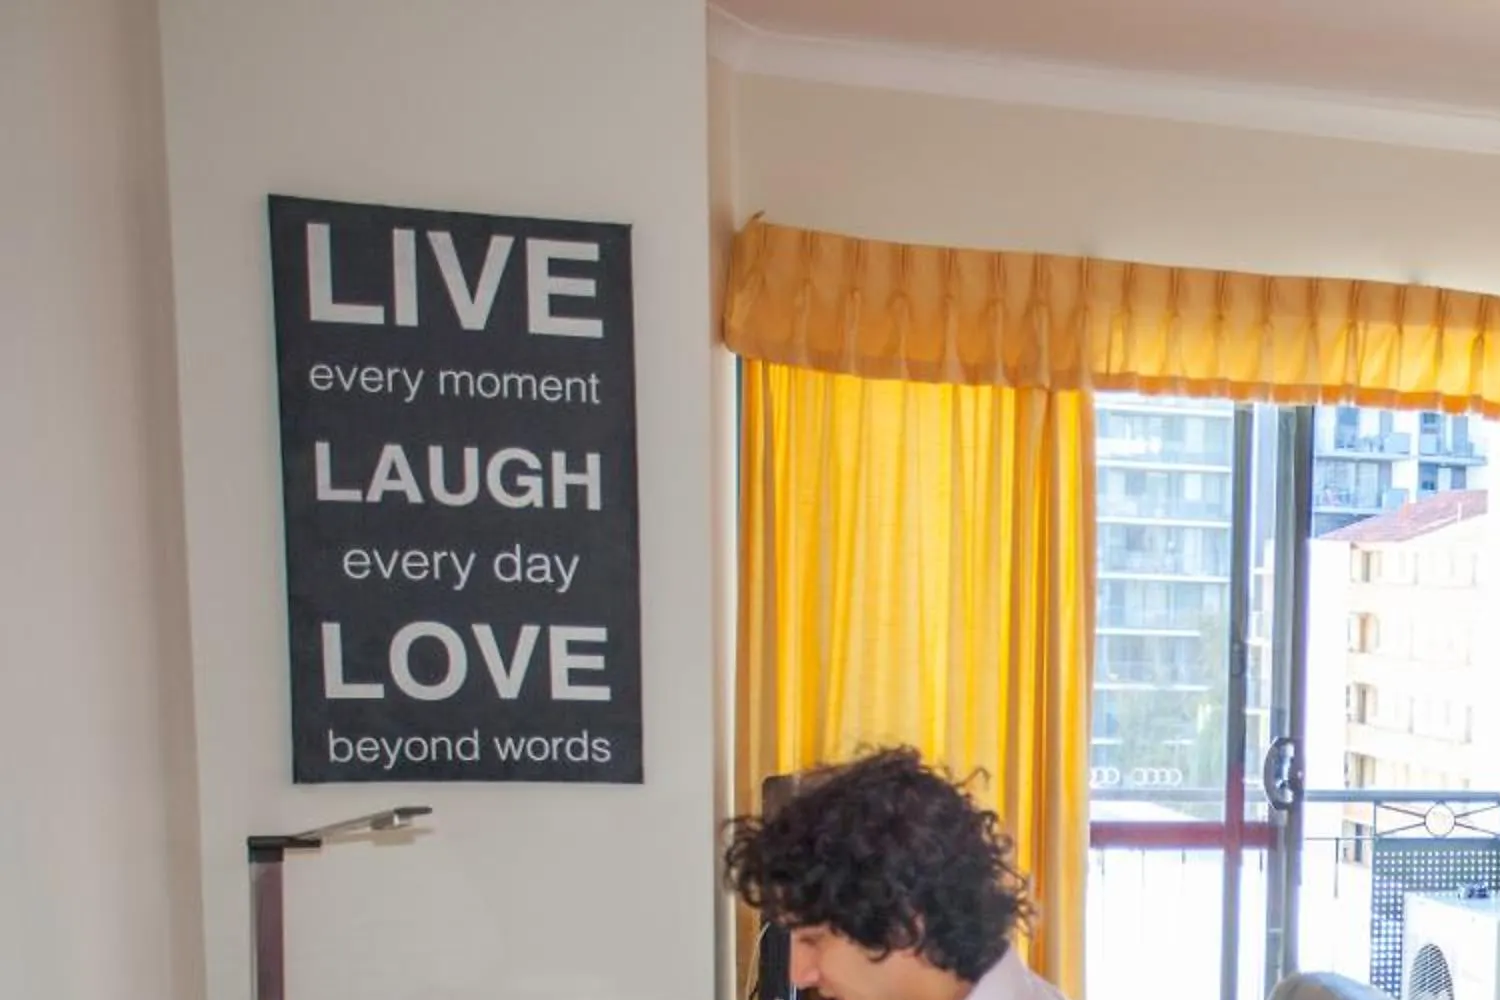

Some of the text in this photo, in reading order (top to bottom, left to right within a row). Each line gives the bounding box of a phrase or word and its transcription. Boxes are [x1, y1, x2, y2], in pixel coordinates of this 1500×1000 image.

[307, 223, 603, 338] LIVE
[309, 364, 601, 404] every moment
[315, 441, 602, 511] LAUGH
[343, 544, 580, 593] every day
[321, 620, 612, 702] LOVE
[328, 728, 612, 770] beyond words
